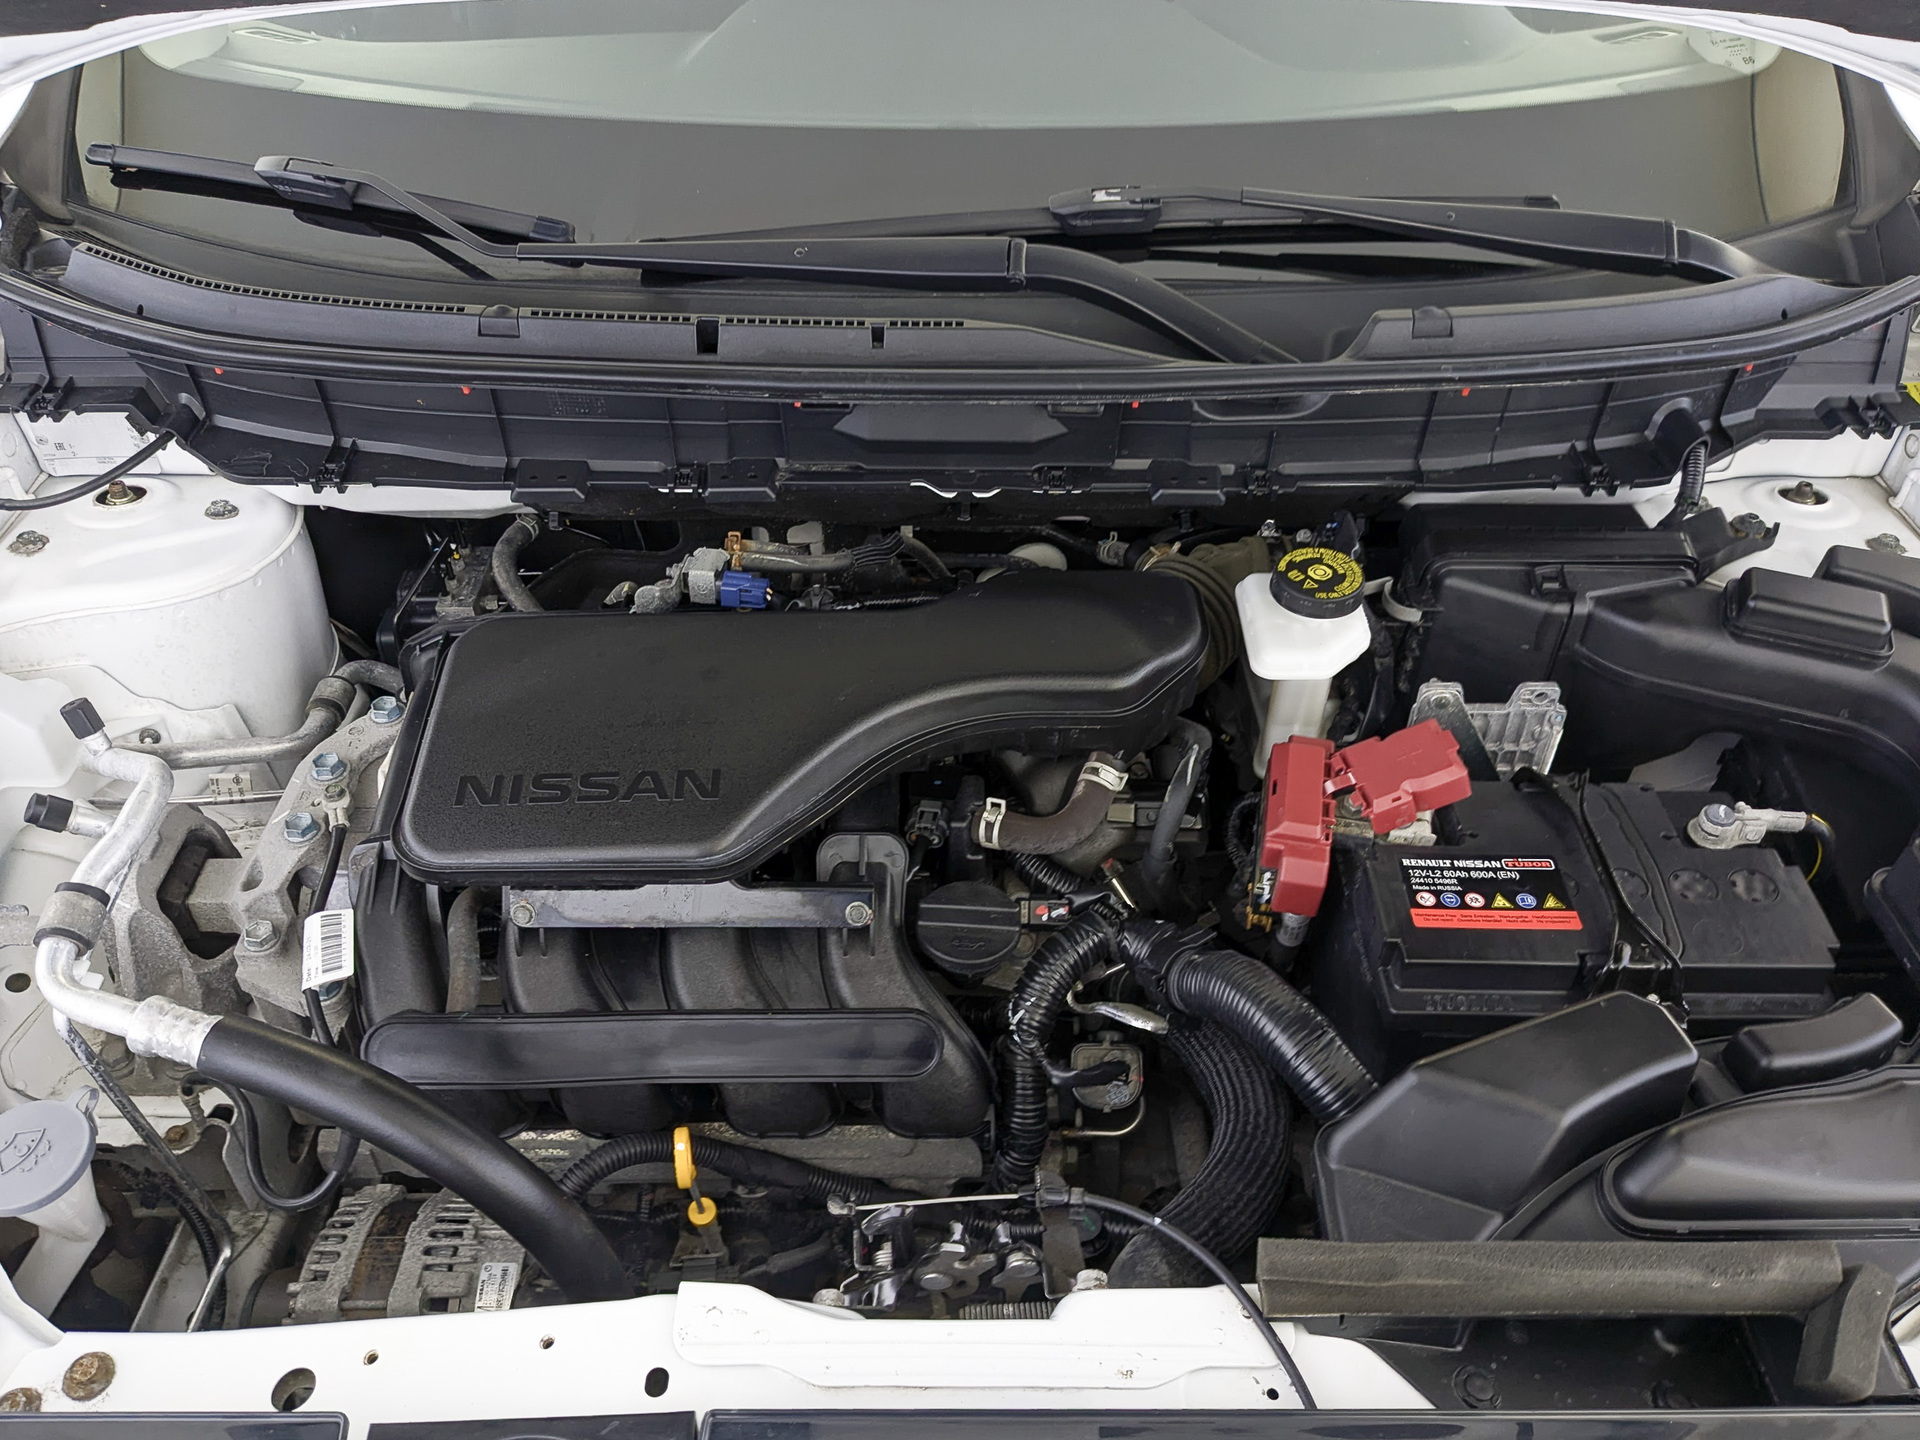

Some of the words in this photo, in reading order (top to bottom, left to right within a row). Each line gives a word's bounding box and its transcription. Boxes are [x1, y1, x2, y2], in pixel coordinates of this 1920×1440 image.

[452, 768, 721, 808] NISSAN
[1401, 858, 1452, 867] RENAULT
[1453, 860, 1501, 868] NISSAN
[1408, 869, 1442, 877] 12V-L2
[1443, 870, 1468, 878] 60Ah
[1497, 871, 1520, 881] (EN)
